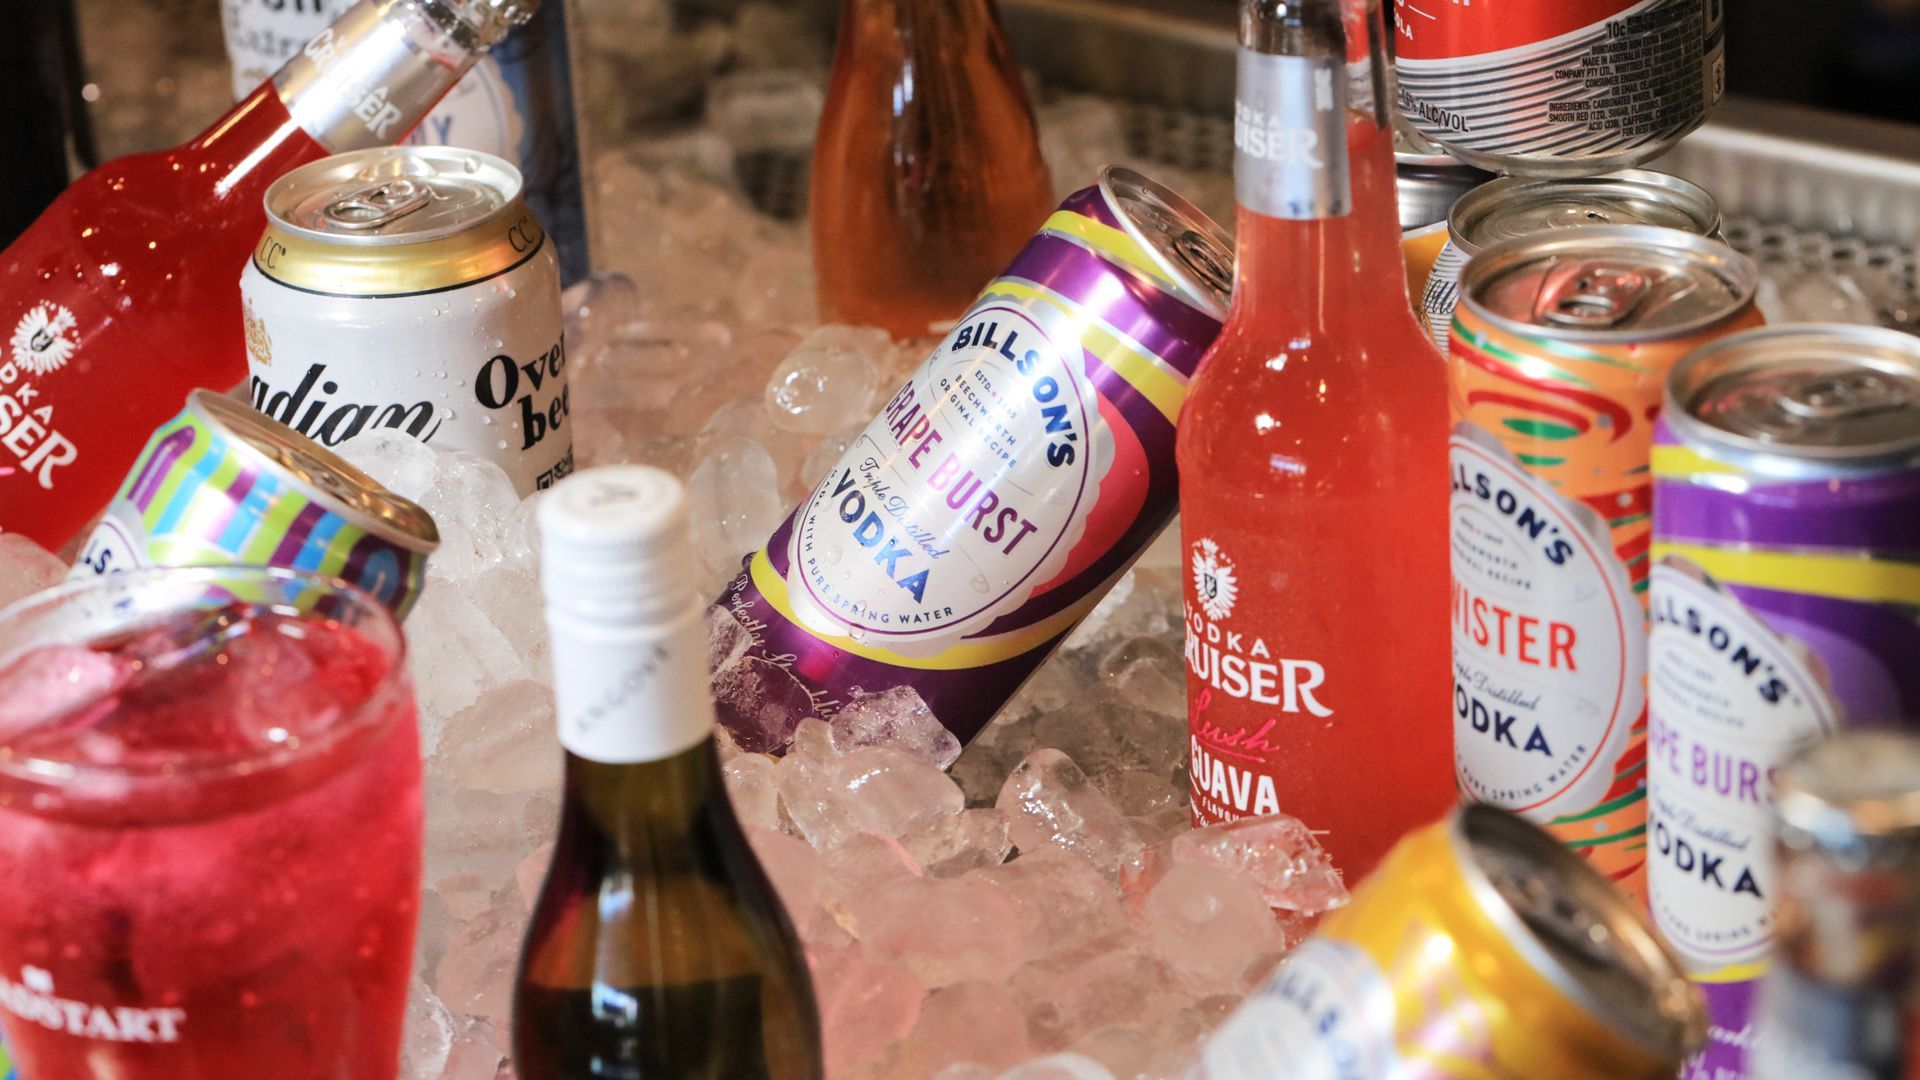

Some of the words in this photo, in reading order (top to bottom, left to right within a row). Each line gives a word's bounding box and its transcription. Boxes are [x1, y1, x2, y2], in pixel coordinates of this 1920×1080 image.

[1607, 22, 1626, 38] 10c
[1555, 68, 1585, 80] COMPANY
[1586, 66, 1598, 77] PTY
[1582, 56, 1600, 67] MADE
[1609, 50, 1641, 63] AUSTRALIA
[1585, 76, 1619, 88] CONSUMER
[1419, 101, 1469, 133] ALC/VOL
[1548, 100, 1591, 112] INGREDIENTS:
[1548, 112, 1575, 123] SMOOTH
[1576, 111, 1589, 121] RED
[1622, 127, 1634, 138] FOR
[951, 321, 1078, 468] BILLSON'S
[859, 457, 892, 501] Triple
[885, 379, 943, 470] GRAPE
[926, 452, 1039, 556] BURST
[1453, 463, 1574, 567] LSON'S
[805, 515, 817, 553] WITH
[831, 467, 930, 605] VODKA
[807, 559, 831, 595] PURE
[832, 594, 891, 624] SPRING
[899, 606, 953, 625] WATER
[1454, 680, 1554, 758] ODKA
[1191, 735, 1281, 816] GUAVA
[1653, 820, 1764, 900] ODKA
